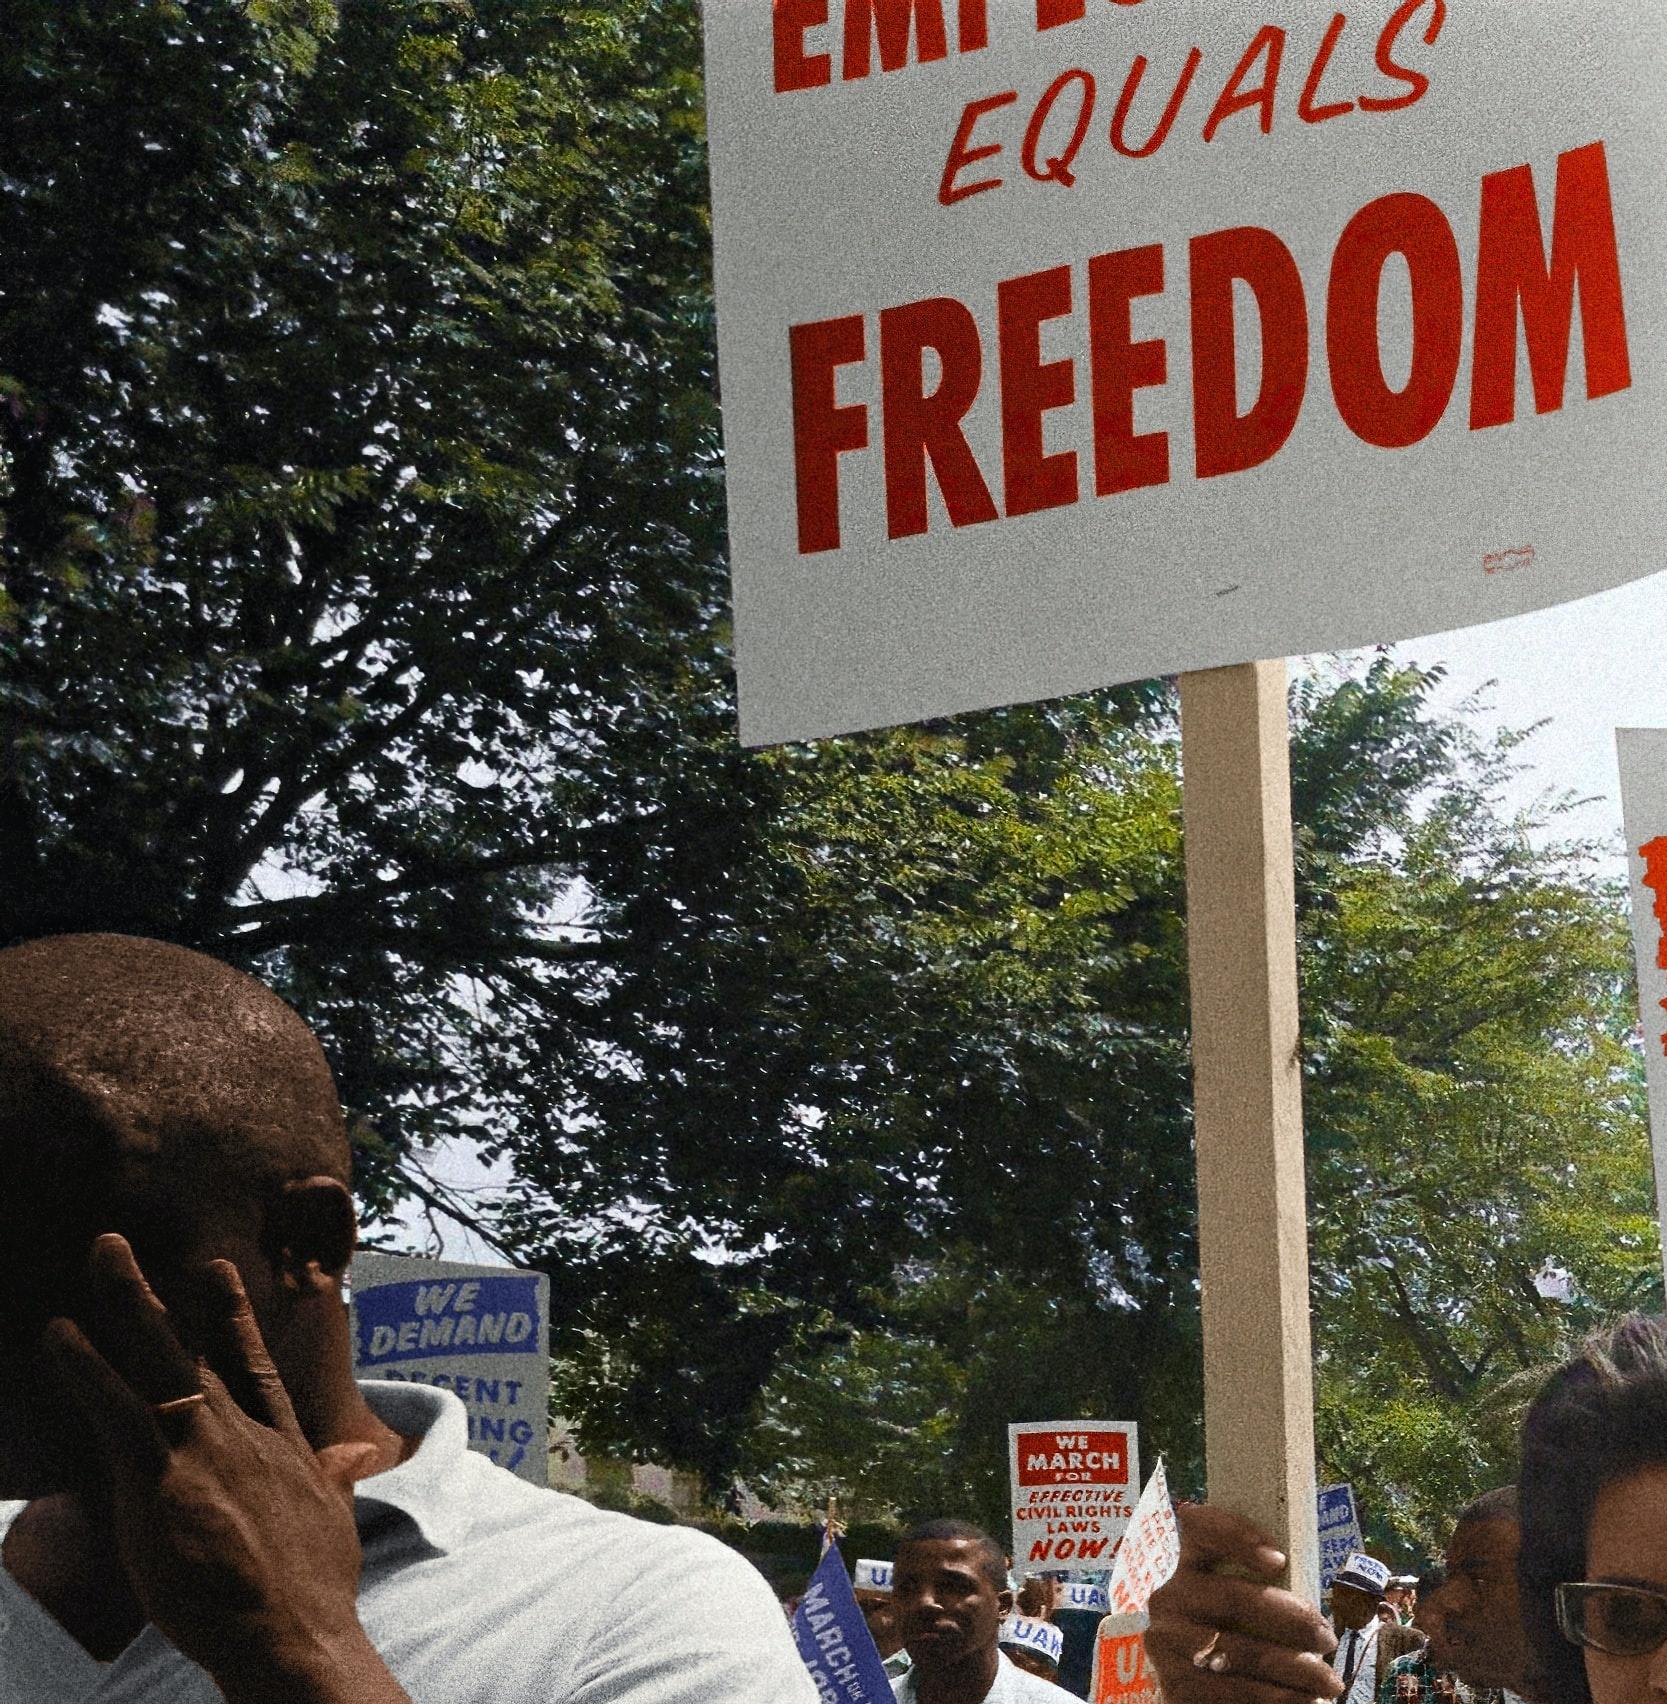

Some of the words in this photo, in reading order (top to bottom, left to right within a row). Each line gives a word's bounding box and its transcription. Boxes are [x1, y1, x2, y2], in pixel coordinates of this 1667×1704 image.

[938, 0, 1446, 206] EQUALS
[789, 140, 1631, 554] FREEDOM
[414, 1282, 481, 1316] WE
[369, 1311, 533, 1357] DEMAND
[468, 1415, 534, 1445] ING
[1056, 1435, 1088, 1449] WE
[1027, 1452, 1120, 1471] MARCH
[1029, 1489, 1126, 1504] EFFECTIVE
[1016, 1507, 1061, 1520] CIVIL
[1065, 1505, 1133, 1518] RIGHTS
[1047, 1521, 1101, 1534] LAWS
[1029, 1536, 1126, 1562] NOW!
[804, 1582, 860, 1686] MARCH
